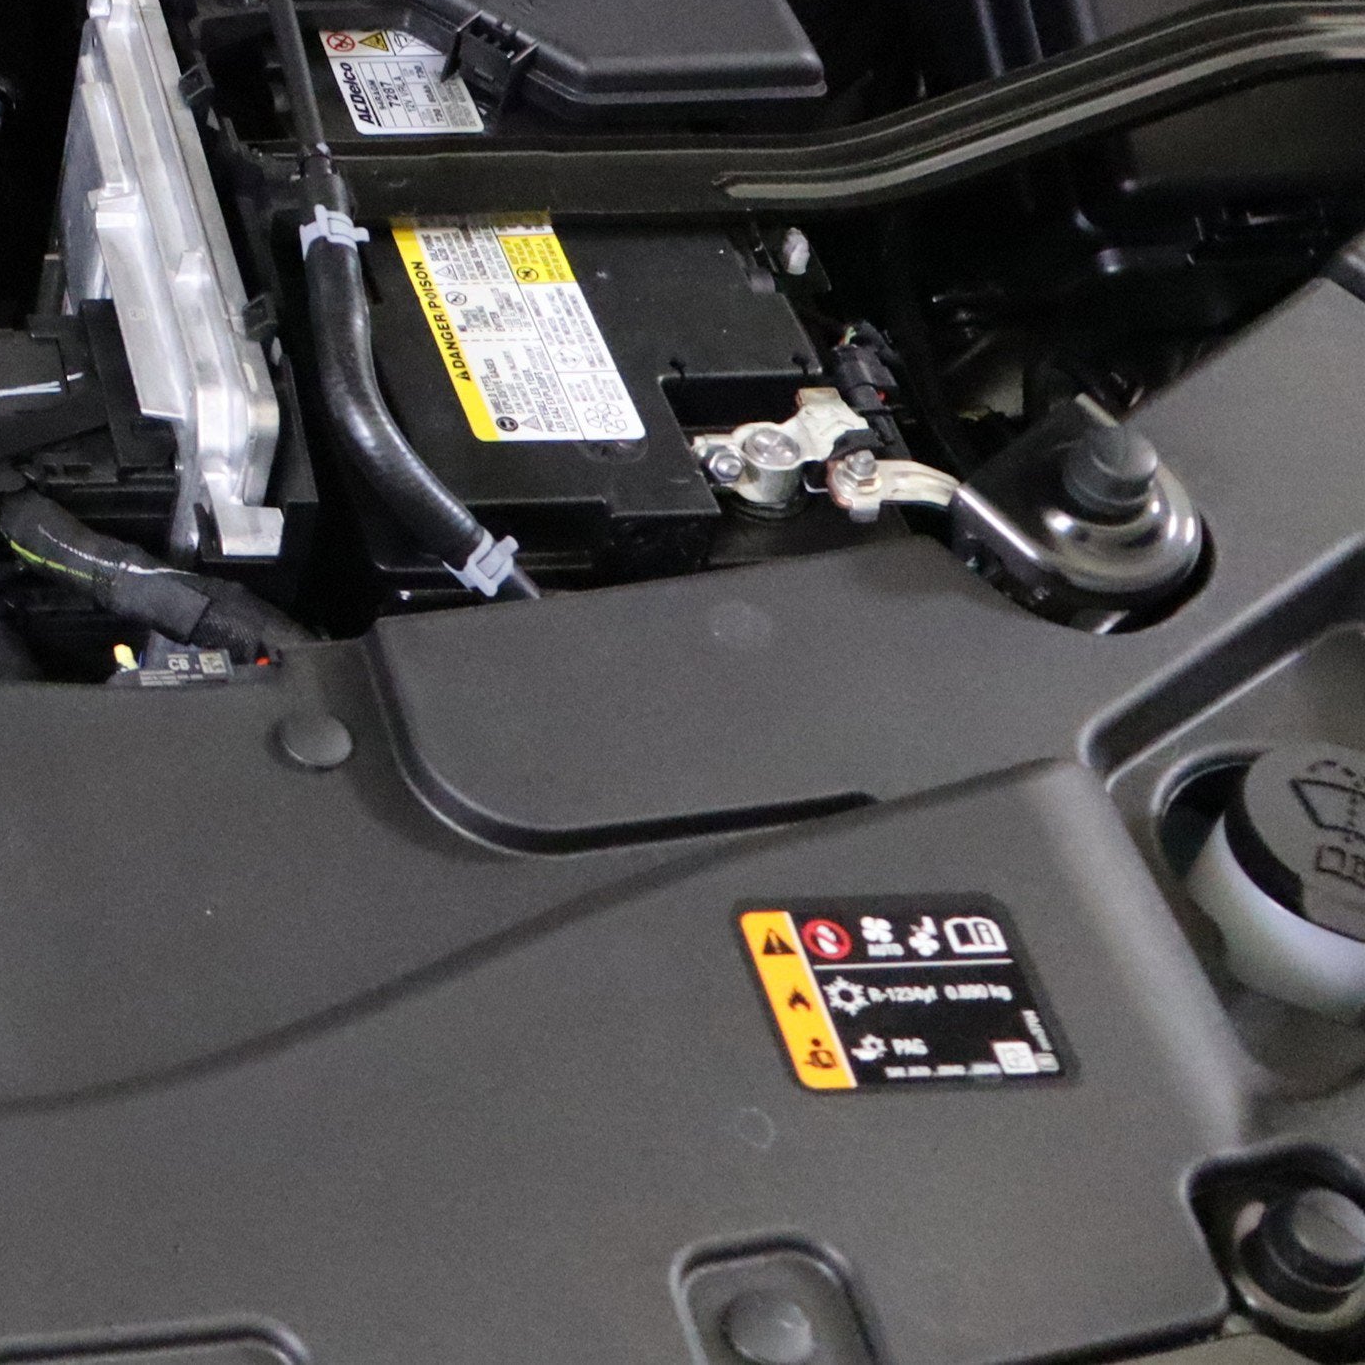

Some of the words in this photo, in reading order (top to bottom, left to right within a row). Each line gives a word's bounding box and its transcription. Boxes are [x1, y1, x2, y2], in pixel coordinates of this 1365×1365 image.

[341, 62, 376, 125] ACDelco
[380, 81, 402, 108] 7287
[891, 1037, 928, 1056] PAG
